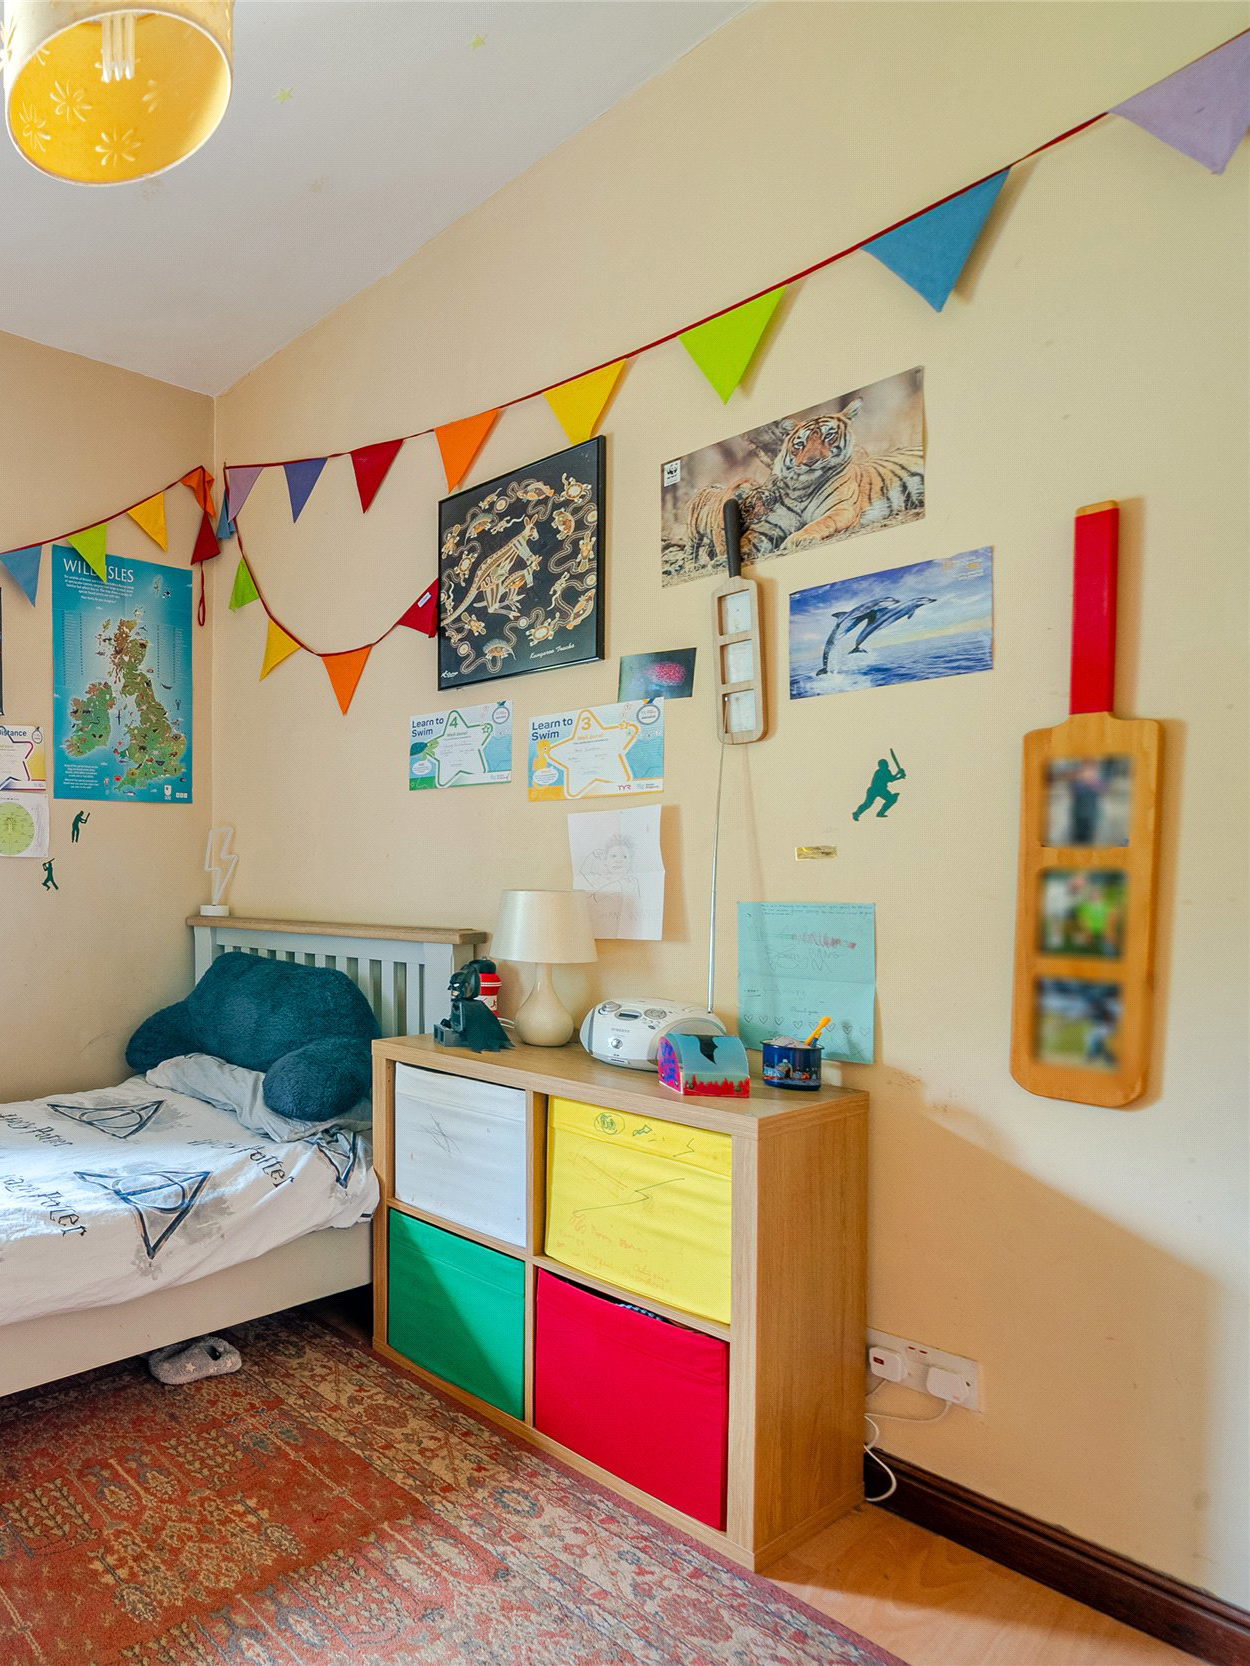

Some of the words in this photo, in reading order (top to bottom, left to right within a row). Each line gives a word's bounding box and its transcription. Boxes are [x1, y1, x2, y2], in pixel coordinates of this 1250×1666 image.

[107, 565, 134, 583] SLES
[412, 719, 435, 729] Learn
[435, 717, 444, 725] to
[449, 716, 459, 728] 4
[532, 721, 562, 731] Learn
[562, 718, 573, 727] to
[581, 717, 591, 731] 3
[412, 728, 434, 738] Swim
[531, 730, 560, 741] Swim
[18, 1126, 73, 1147] Potter
[16, 1191, 87, 1237] Potter
